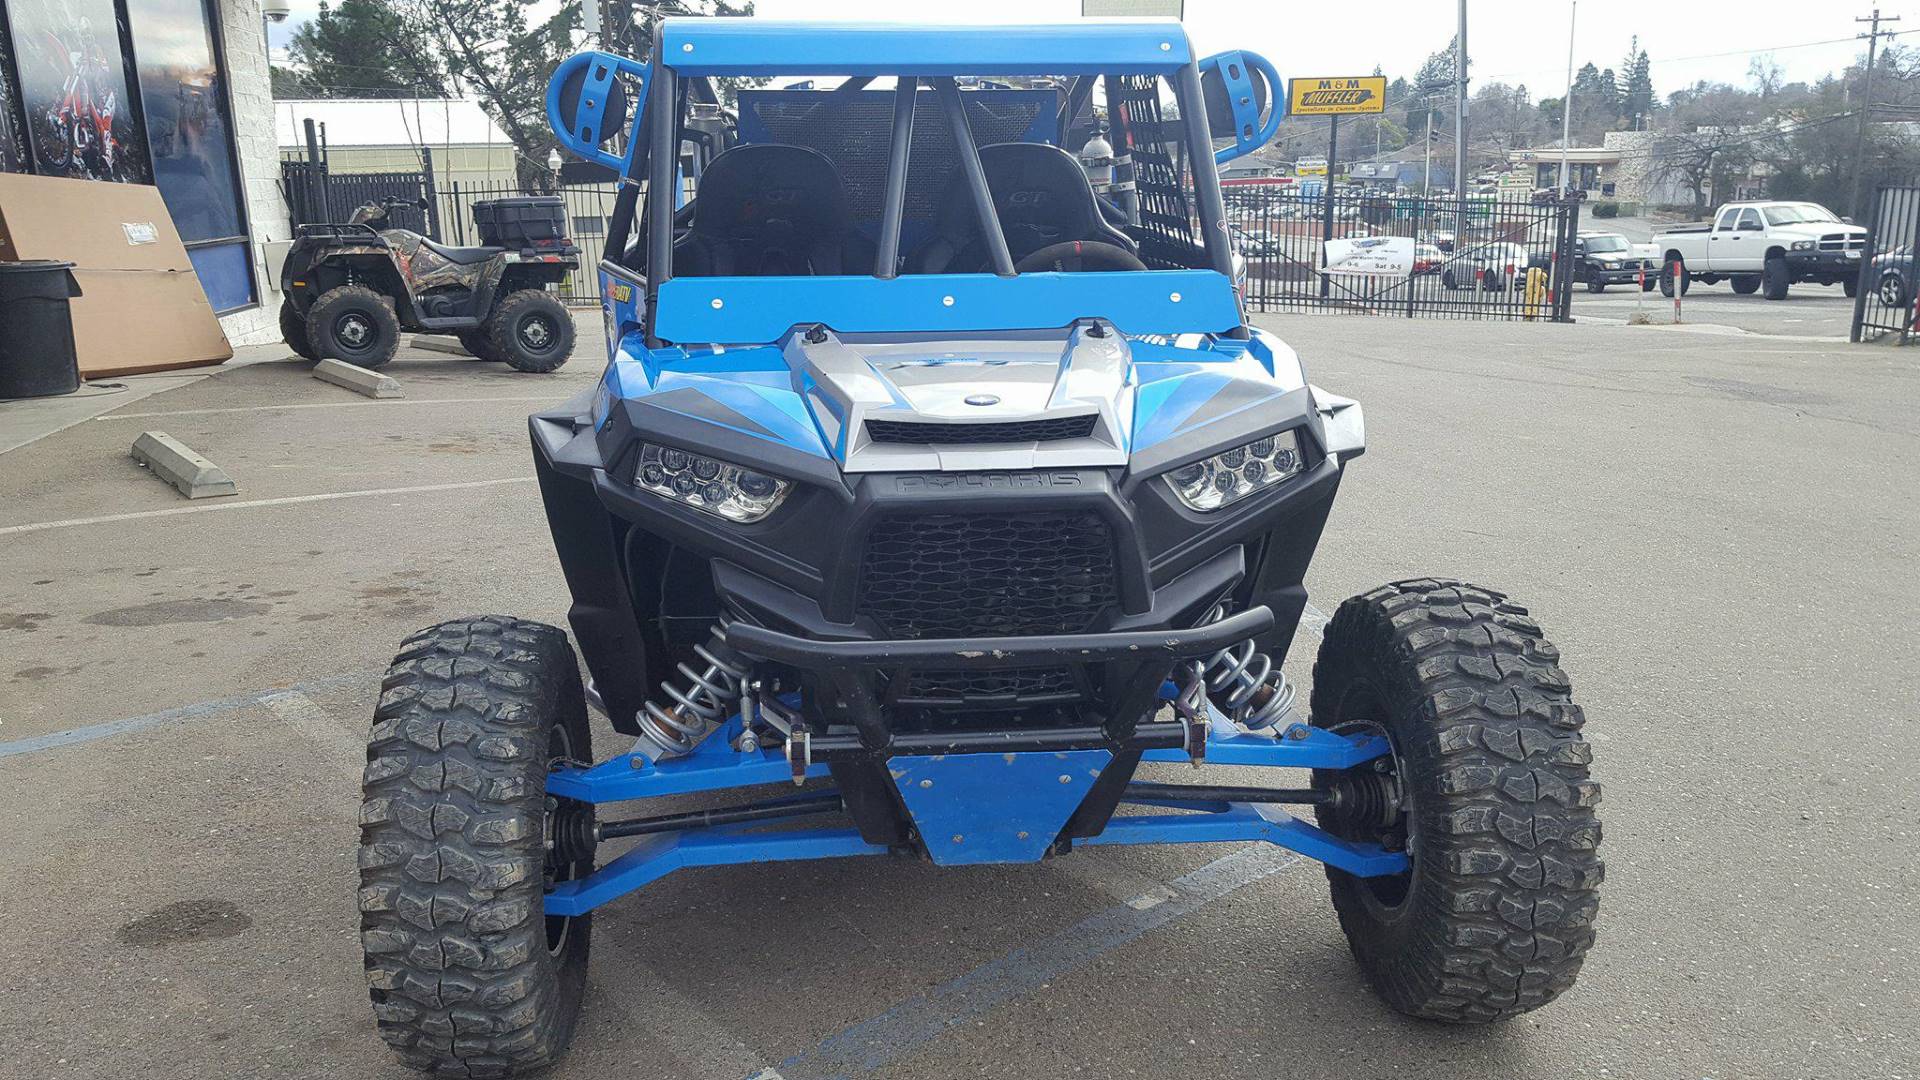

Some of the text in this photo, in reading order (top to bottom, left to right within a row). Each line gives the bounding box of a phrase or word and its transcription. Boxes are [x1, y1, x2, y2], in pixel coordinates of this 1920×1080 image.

[1318, 79, 1360, 89] M & M
[1304, 90, 1361, 104] MUFFLER
[1009, 191, 1047, 202] GT
[896, 472, 1082, 494] POLARIS
